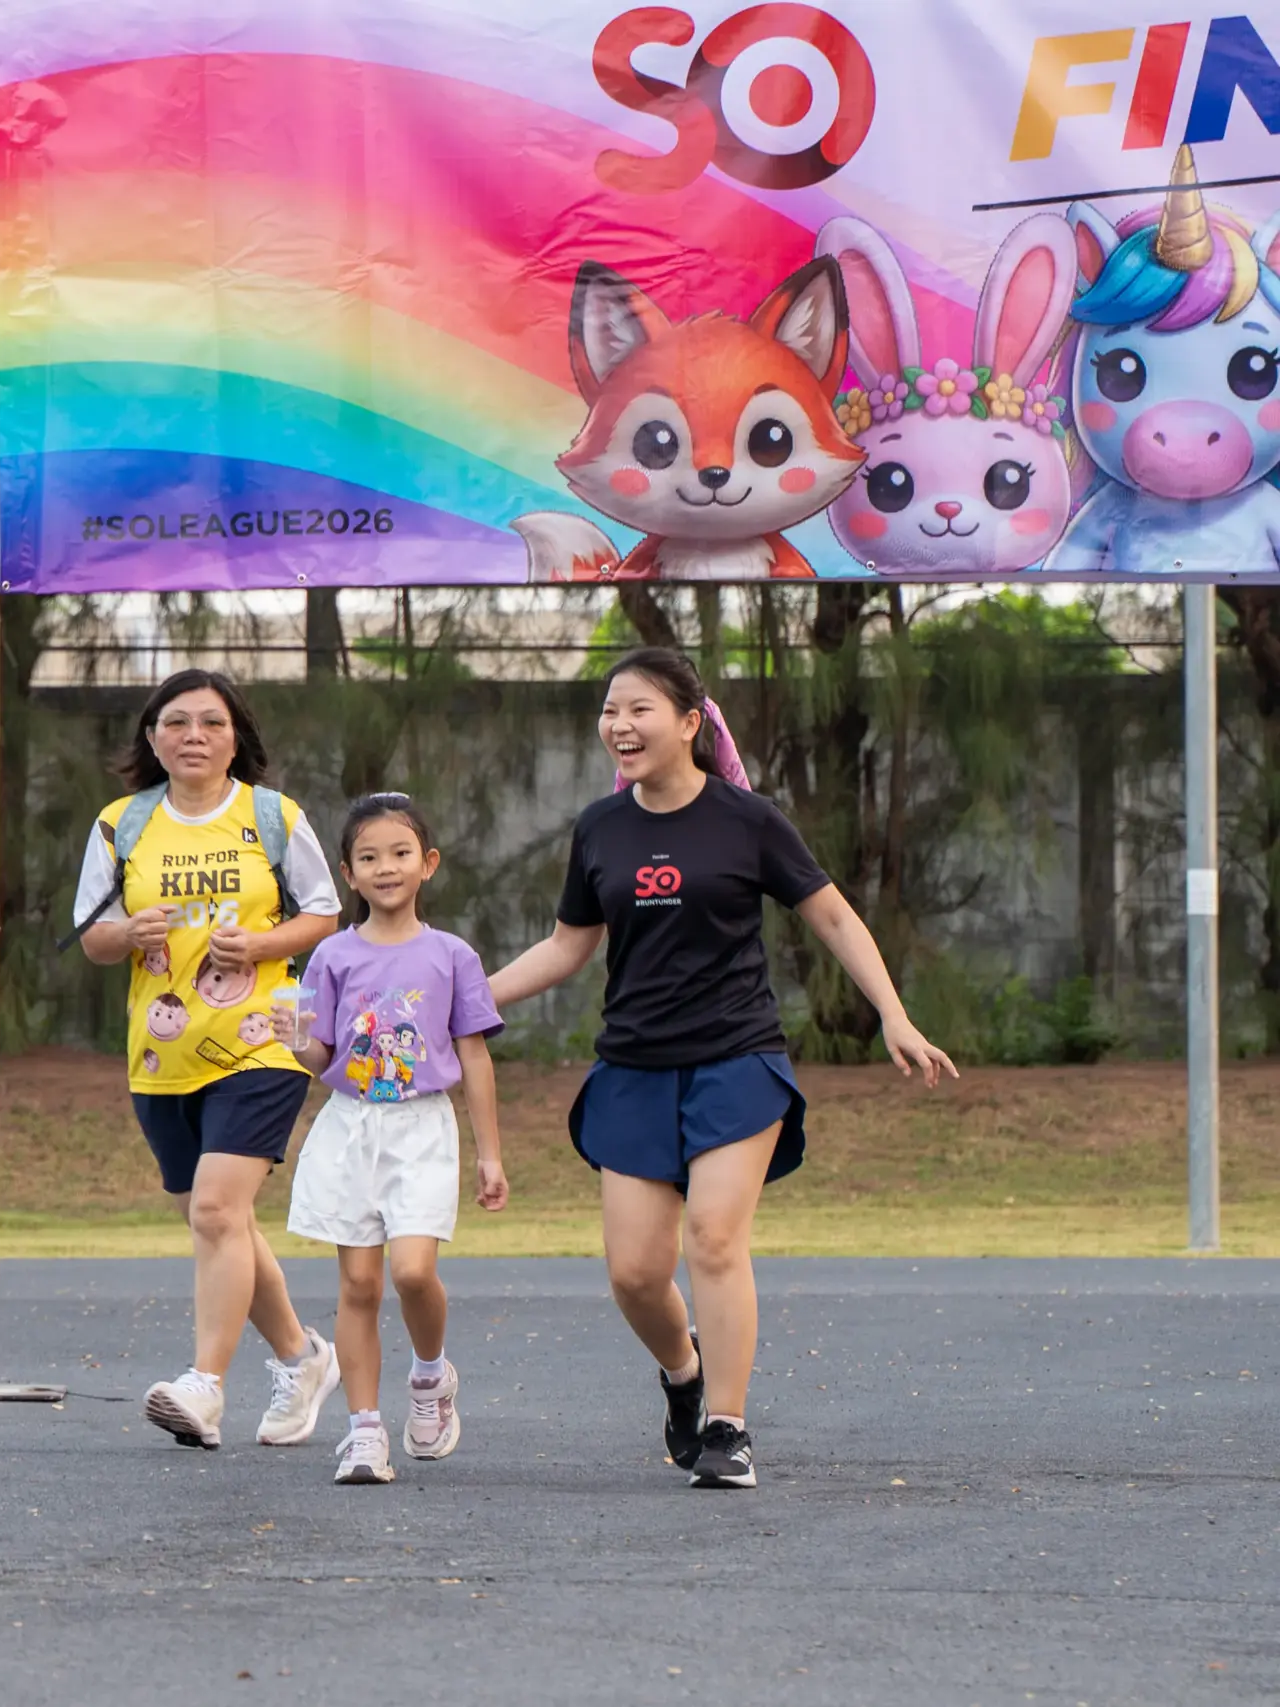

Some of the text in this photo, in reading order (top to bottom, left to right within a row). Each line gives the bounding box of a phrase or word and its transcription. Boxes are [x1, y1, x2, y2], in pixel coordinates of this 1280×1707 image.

[593, 2, 876, 194] SO
[82, 508, 394, 541] #SOLEAGUE2026
[162, 849, 239, 867] RUN FOR
[160, 868, 240, 897] KING
[635, 865, 682, 897] SO
